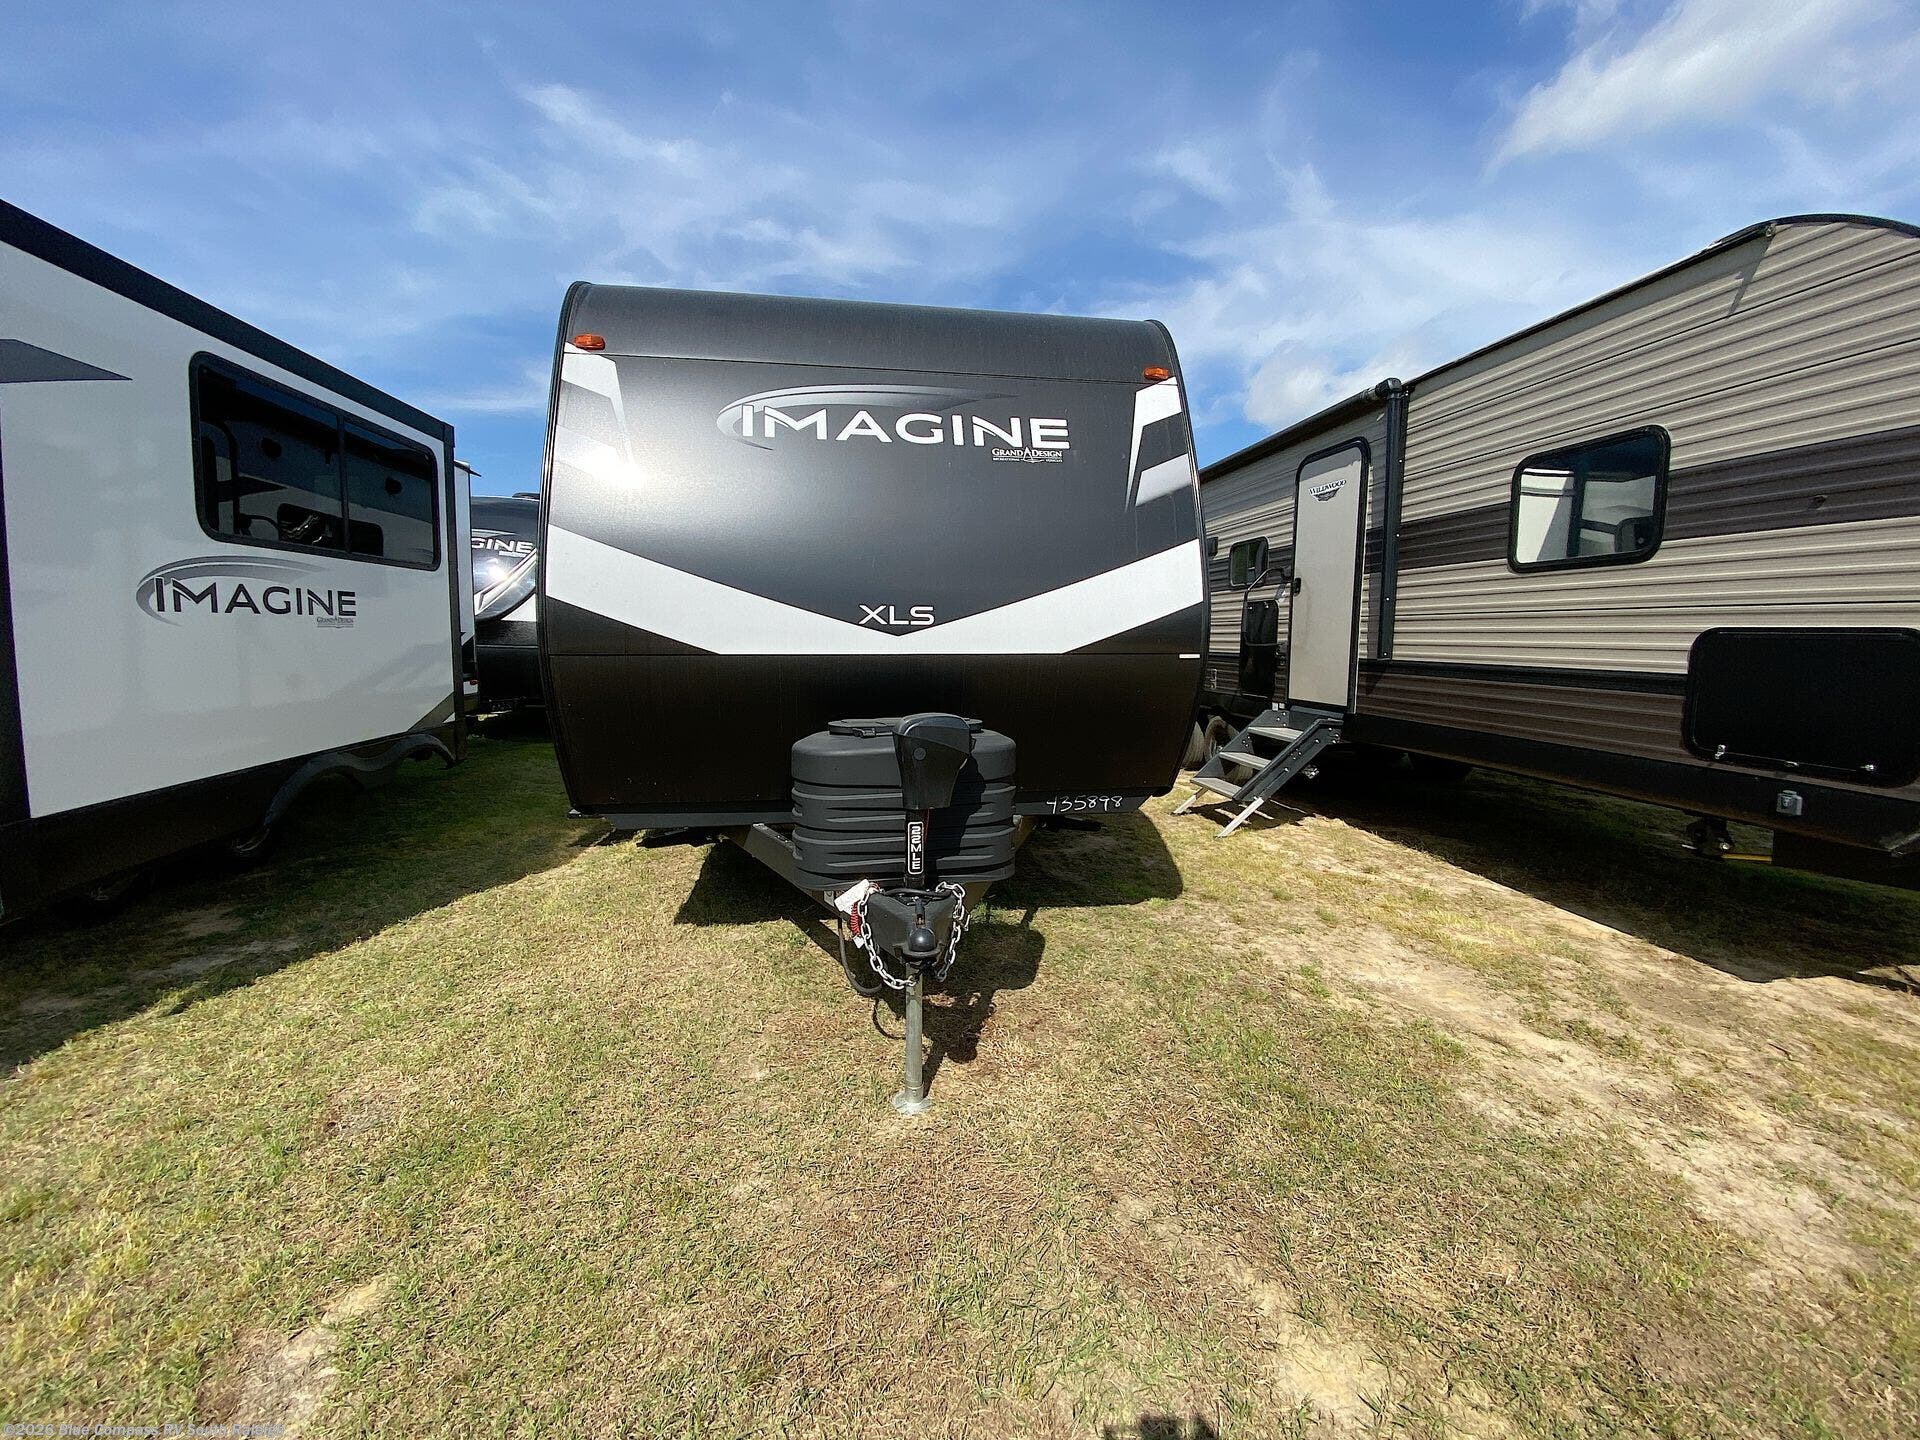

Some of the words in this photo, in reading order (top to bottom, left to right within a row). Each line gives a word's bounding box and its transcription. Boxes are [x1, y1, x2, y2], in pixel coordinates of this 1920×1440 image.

[742, 404, 1070, 449] IMAGINE
[992, 448, 1023, 456] GRAND
[1031, 449, 1062, 457] DESIGN
[155, 577, 356, 616] IMAGINE
[858, 604, 935, 625] XLS
[911, 826, 922, 870] 22MLE
